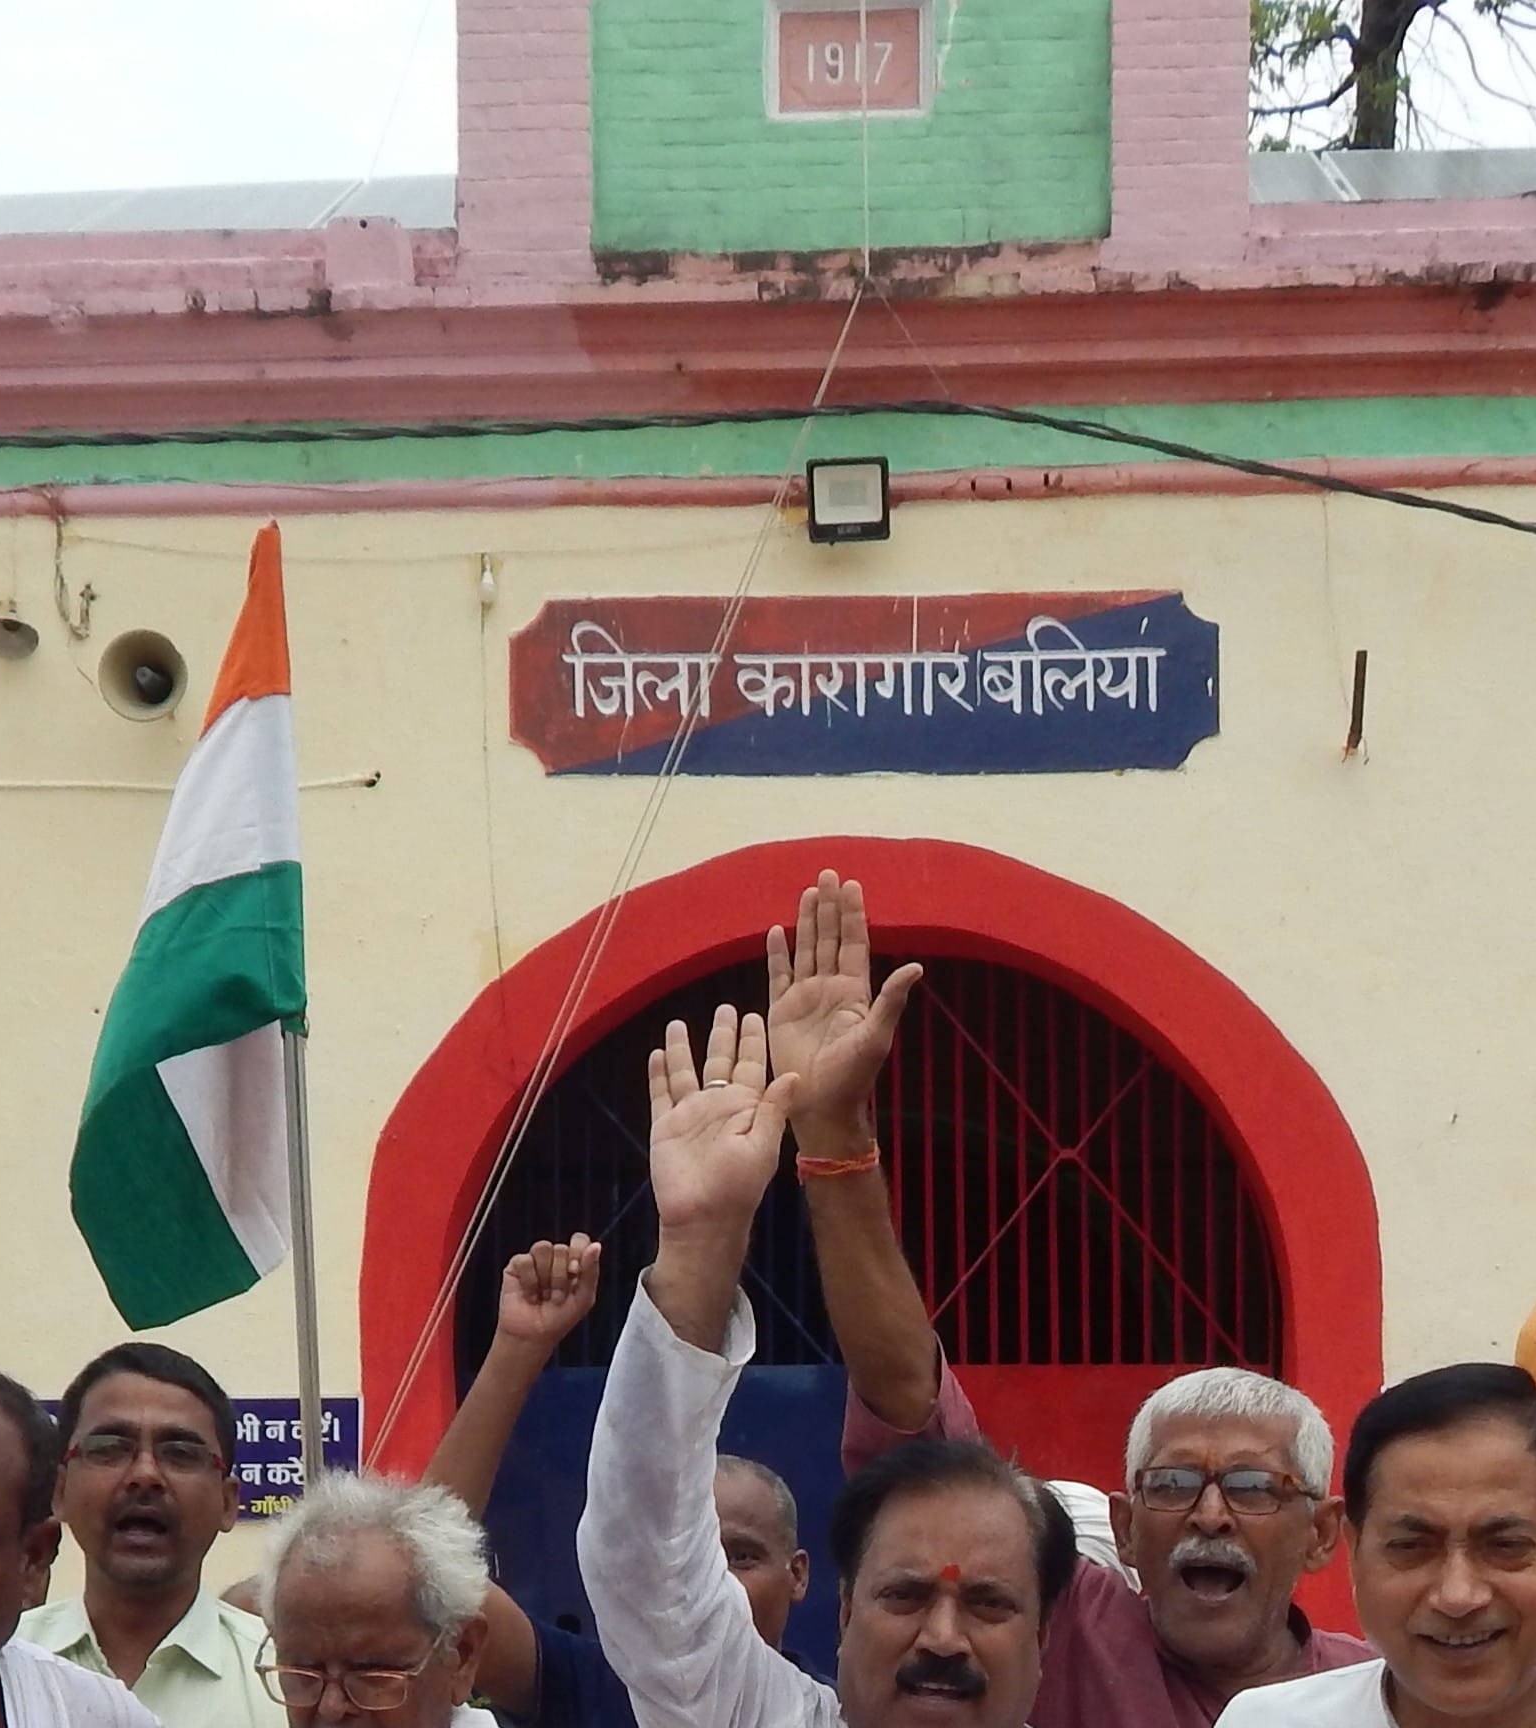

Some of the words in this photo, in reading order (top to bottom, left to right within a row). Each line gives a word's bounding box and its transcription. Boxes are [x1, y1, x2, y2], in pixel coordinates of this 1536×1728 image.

[807, 41, 894, 85] 1917
[562, 620, 722, 718] जिला
[733, 651, 973, 718] कारागार
[983, 615, 1167, 716] बलिया
[264, 1420, 286, 1443] न
[240, 1463, 262, 1486] न
